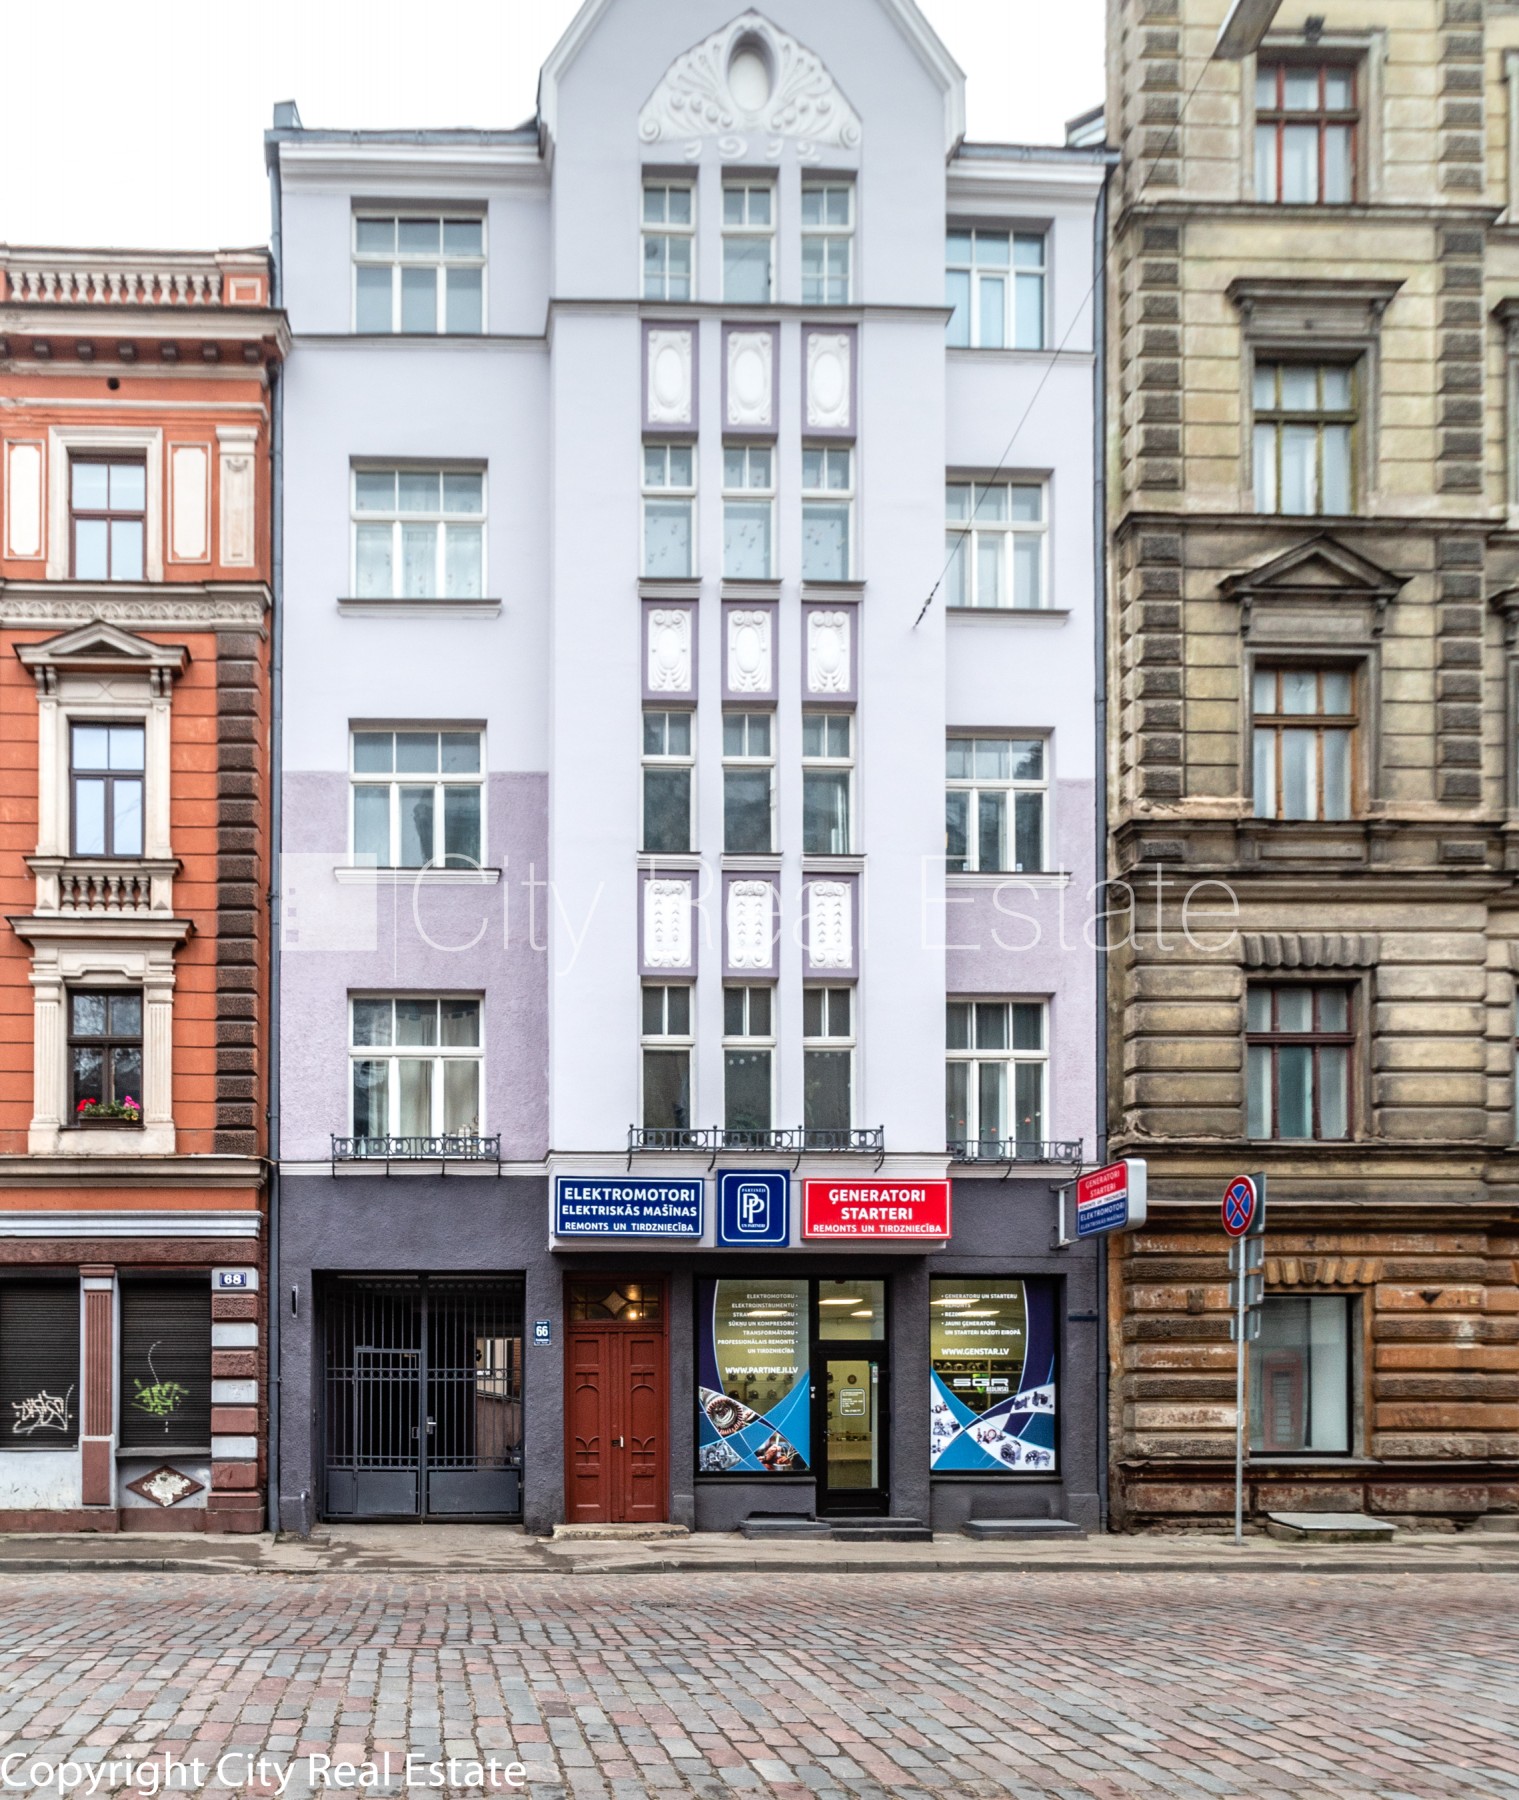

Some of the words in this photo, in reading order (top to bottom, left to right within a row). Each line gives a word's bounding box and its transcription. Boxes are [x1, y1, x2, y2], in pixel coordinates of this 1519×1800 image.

[564, 1187, 695, 1202] ELEKTROMOTORI
[828, 1188, 926, 1205] ĢENERATORI
[1090, 1182, 1116, 1198] STARTERI
[562, 1204, 640, 1216] ELEKTRISKĀS
[643, 1204, 697, 1217] MAŠĪNAS
[841, 1207, 913, 1220] STARTERI
[1080, 1202, 1125, 1221] ELEKTROMOTORI
[565, 1222, 609, 1231] REMONTS
[613, 1222, 627, 1231] UN
[631, 1221, 694, 1232] TIRDZNIECĪBA
[813, 1224, 857, 1233] REMONTS
[861, 1224, 875, 1233] UN
[879, 1223, 942, 1233] TIRDZNIECĪBA
[224, 1274, 242, 1284] 68
[536, 1325, 548, 1337] 66
[953, 1378, 1009, 1387] SGR
